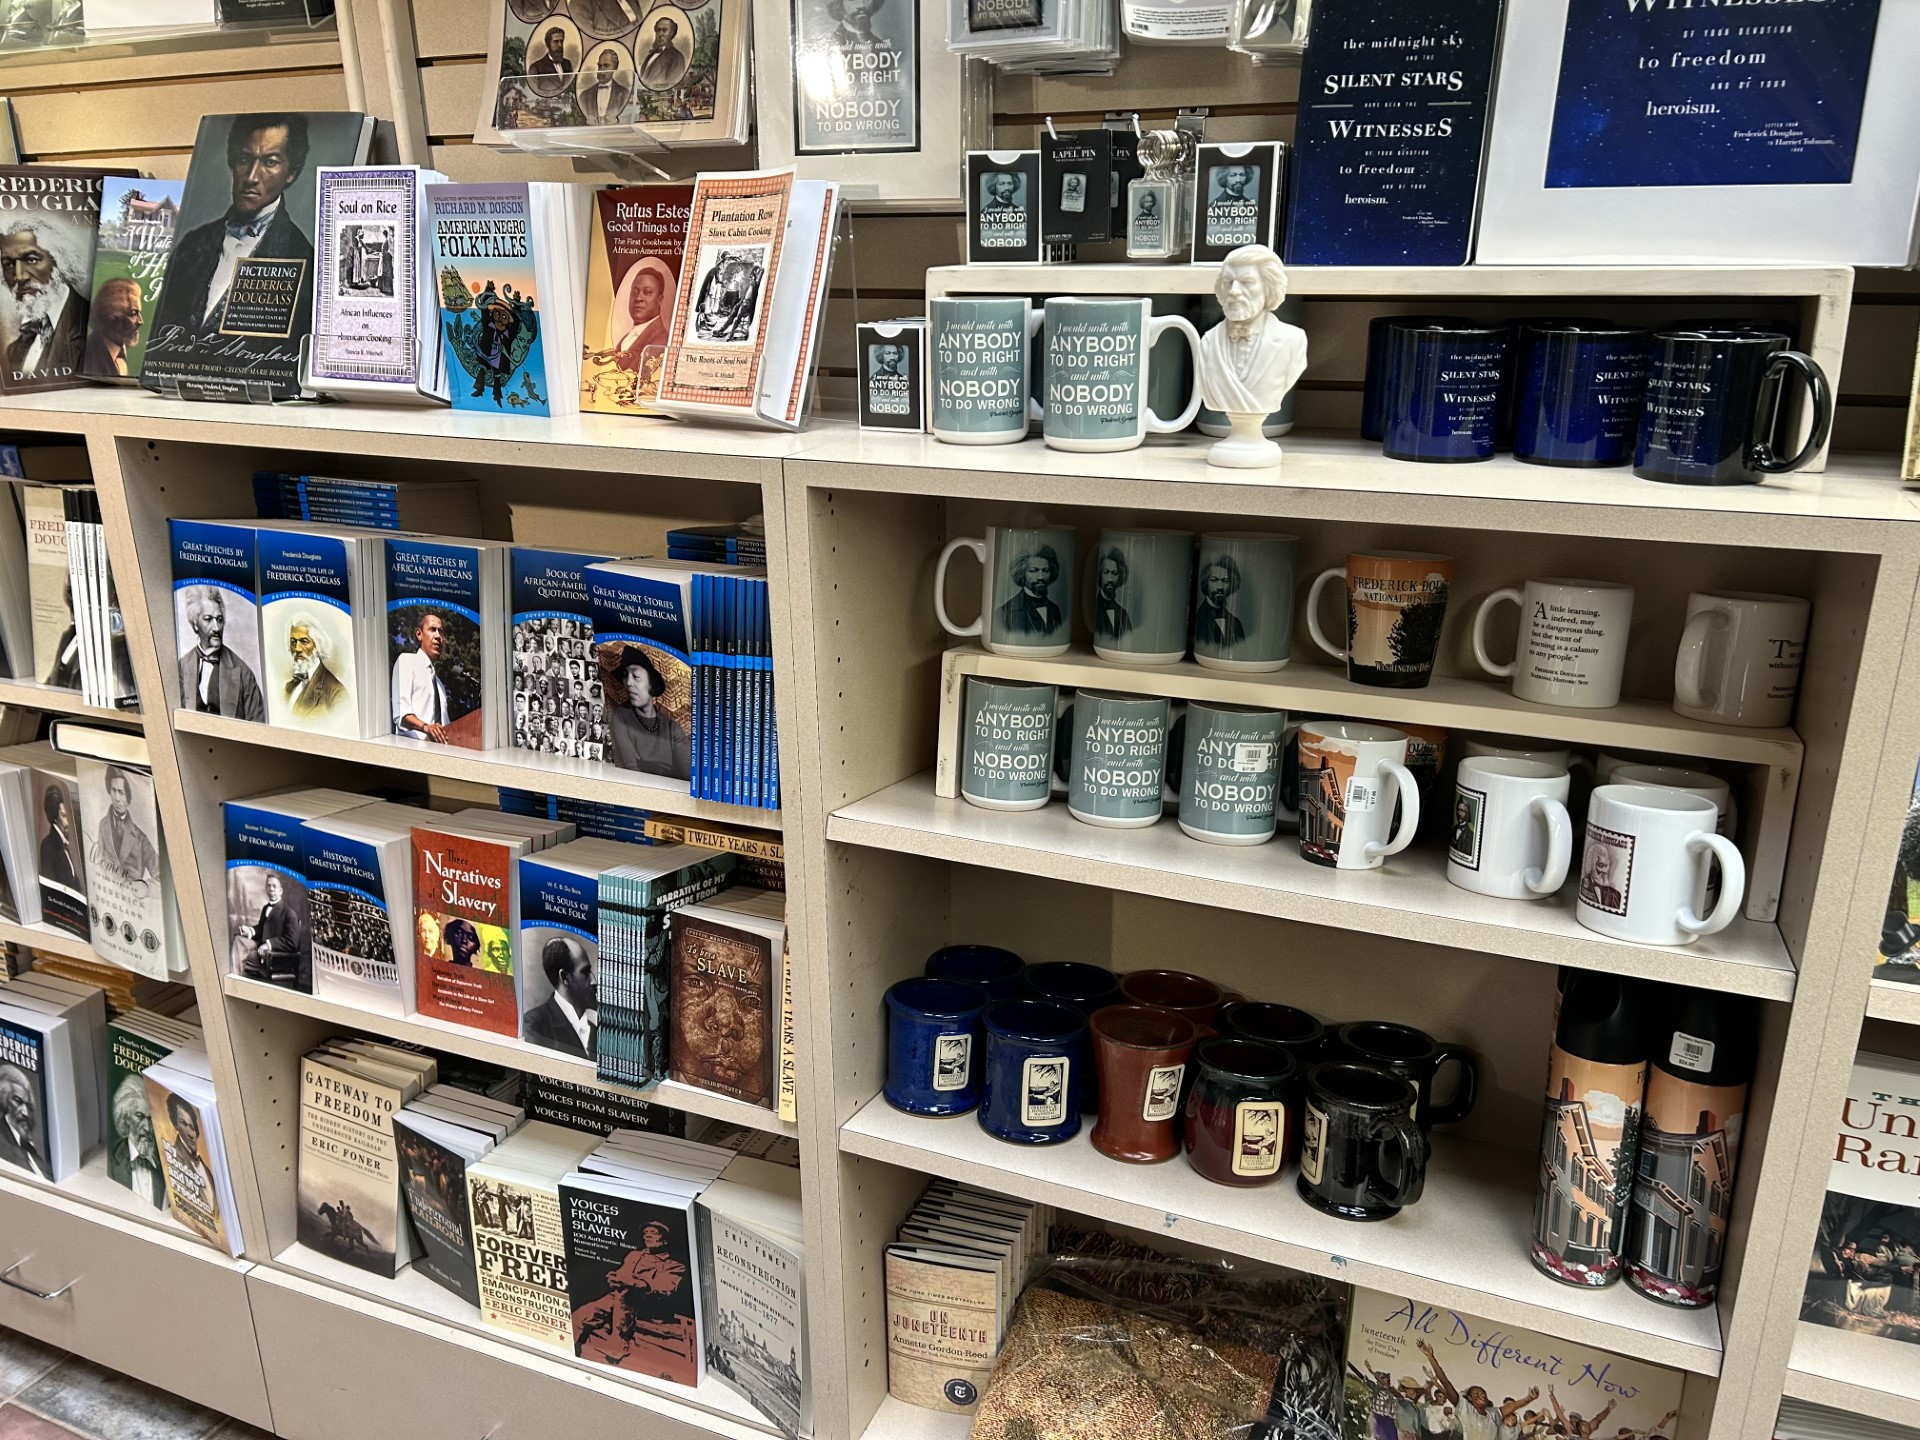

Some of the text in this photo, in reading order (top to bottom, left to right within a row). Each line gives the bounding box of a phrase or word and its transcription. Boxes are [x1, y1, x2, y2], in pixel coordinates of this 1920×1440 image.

[1343, 34, 1465, 50] the midnight sky
[1638, 49, 1767, 70] to freedom
[861, 70, 900, 84] RIGHT
[1324, 70, 1464, 95] SILENT STARS
[816, 99, 901, 120] NOBODY
[1646, 98, 1721, 117] heroism.
[856, 119, 900, 131] WRONG
[1328, 117, 1453, 139] WITNESSES
[1733, 128, 1804, 139] Frederick Douglass
[1052, 149, 1096, 159] LAPEL PIN
[1339, 163, 1416, 175] to freedom
[338, 200, 397, 214] Soul on Rice
[1344, 193, 1389, 205] heroism.
[434, 202, 524, 215] RICHARD M. DORSON
[616, 202, 652, 220] Rufus
[711, 208, 774, 223] Plantation Row
[437, 220, 526, 235] AMERICAN NEGRO
[606, 222, 680, 235] Good Things to
[708, 227, 772, 238] Slave Cabin Cooking
[440, 236, 528, 258] FOLKTALES
[612, 246, 673, 256] African-American
[613, 238, 682, 248] The First Cookbook by
[239, 266, 297, 278] PICTURING
[236, 278, 294, 292] FREDERICK
[232, 292, 292, 306] DOUGLASS
[340, 308, 393, 319] African Influences
[366, 334, 392, 345] Cooking
[938, 331, 1022, 350] ANYBODY
[685, 355, 697, 364] The
[698, 356, 715, 364] Roots
[938, 350, 1021, 364] TO DO RIGHT
[12, 366, 73, 381] DAVID
[960, 366, 999, 377] and with
[940, 379, 1020, 397] NOBODY
[1676, 382, 1711, 393] STARS
[940, 397, 1020, 410] TO DO WRONG
[1646, 402, 1705, 418] WITNESSES
[182, 540, 244, 557] GREAT SPEECHES BY
[179, 550, 248, 568] FREDERICK DOUGLASS
[395, 552, 469, 569] GREAT SPEECHES BY
[266, 570, 341, 586] FREDERICK DOUGLASS
[392, 562, 473, 581] AFRICAN AMERICANS
[546, 568, 581, 581] BOOK OF
[1352, 576, 1417, 592] FREDERICK
[538, 586, 590, 601] QUOTATIONS
[592, 584, 674, 610] GREAT SHORT STORIES
[1364, 591, 1406, 603] NATIONAL
[603, 600, 678, 622] AFRICAN-AMERICAN
[1550, 604, 1600, 618] little learning,
[619, 612, 652, 628] WRITERS
[1546, 623, 1583, 634] dangerous
[1551, 615, 1596, 628] indeed, may
[1532, 630, 1583, 644] but the want of
[1530, 639, 1600, 656] learning calamity
[1536, 650, 1548, 660] any
[1376, 662, 1418, 673] WASHINGTON
[1086, 725, 1165, 744] ANYBODY
[1084, 766, 1162, 786] NOBODY
[238, 832, 295, 853] UP FROM SLAVERY
[688, 830, 768, 857] TWELVE YEARS A
[446, 848, 470, 866] Three
[309, 856, 375, 882] GREATEST SPEECHES
[422, 849, 502, 890] Narratives
[656, 872, 726, 906] NARRATIVE OF MY
[428, 880, 498, 918] of Slavery
[540, 890, 590, 912] THE SOULS OF
[666, 886, 718, 912] ESCAPE FROM
[544, 902, 587, 921] BLACK FOLK
[696, 956, 748, 984] SLAVE
[305, 1070, 392, 1112] GATEWAY TO
[314, 1091, 382, 1127] FREEDOM
[311, 1136, 338, 1154] ERIC
[342, 1148, 382, 1170] FONER
[165, 1150, 207, 1189] Bondage
[569, 1196, 620, 1216] VOICES
[571, 1208, 611, 1226] FROM
[572, 1220, 628, 1240] SLAVERY
[476, 1232, 567, 1272] FOREVER
[477, 1247, 569, 1293] FREE
[716, 1244, 797, 1300] RECONSTRUCTION
[482, 1276, 560, 1307] EMANCIPATION
[482, 1286, 571, 1320] RECONSTRUCTION
[491, 1300, 522, 1316] ERIC
[525, 1308, 568, 1330] FONER
[930, 1310, 949, 1325] ON
[893, 1314, 988, 1344] JUNETEENTH
[1360, 1322, 1407, 1346] Juneteenth
[892, 1334, 988, 1360] Annette Gordon-Reed
[1384, 1296, 1642, 1400] All Different Now
